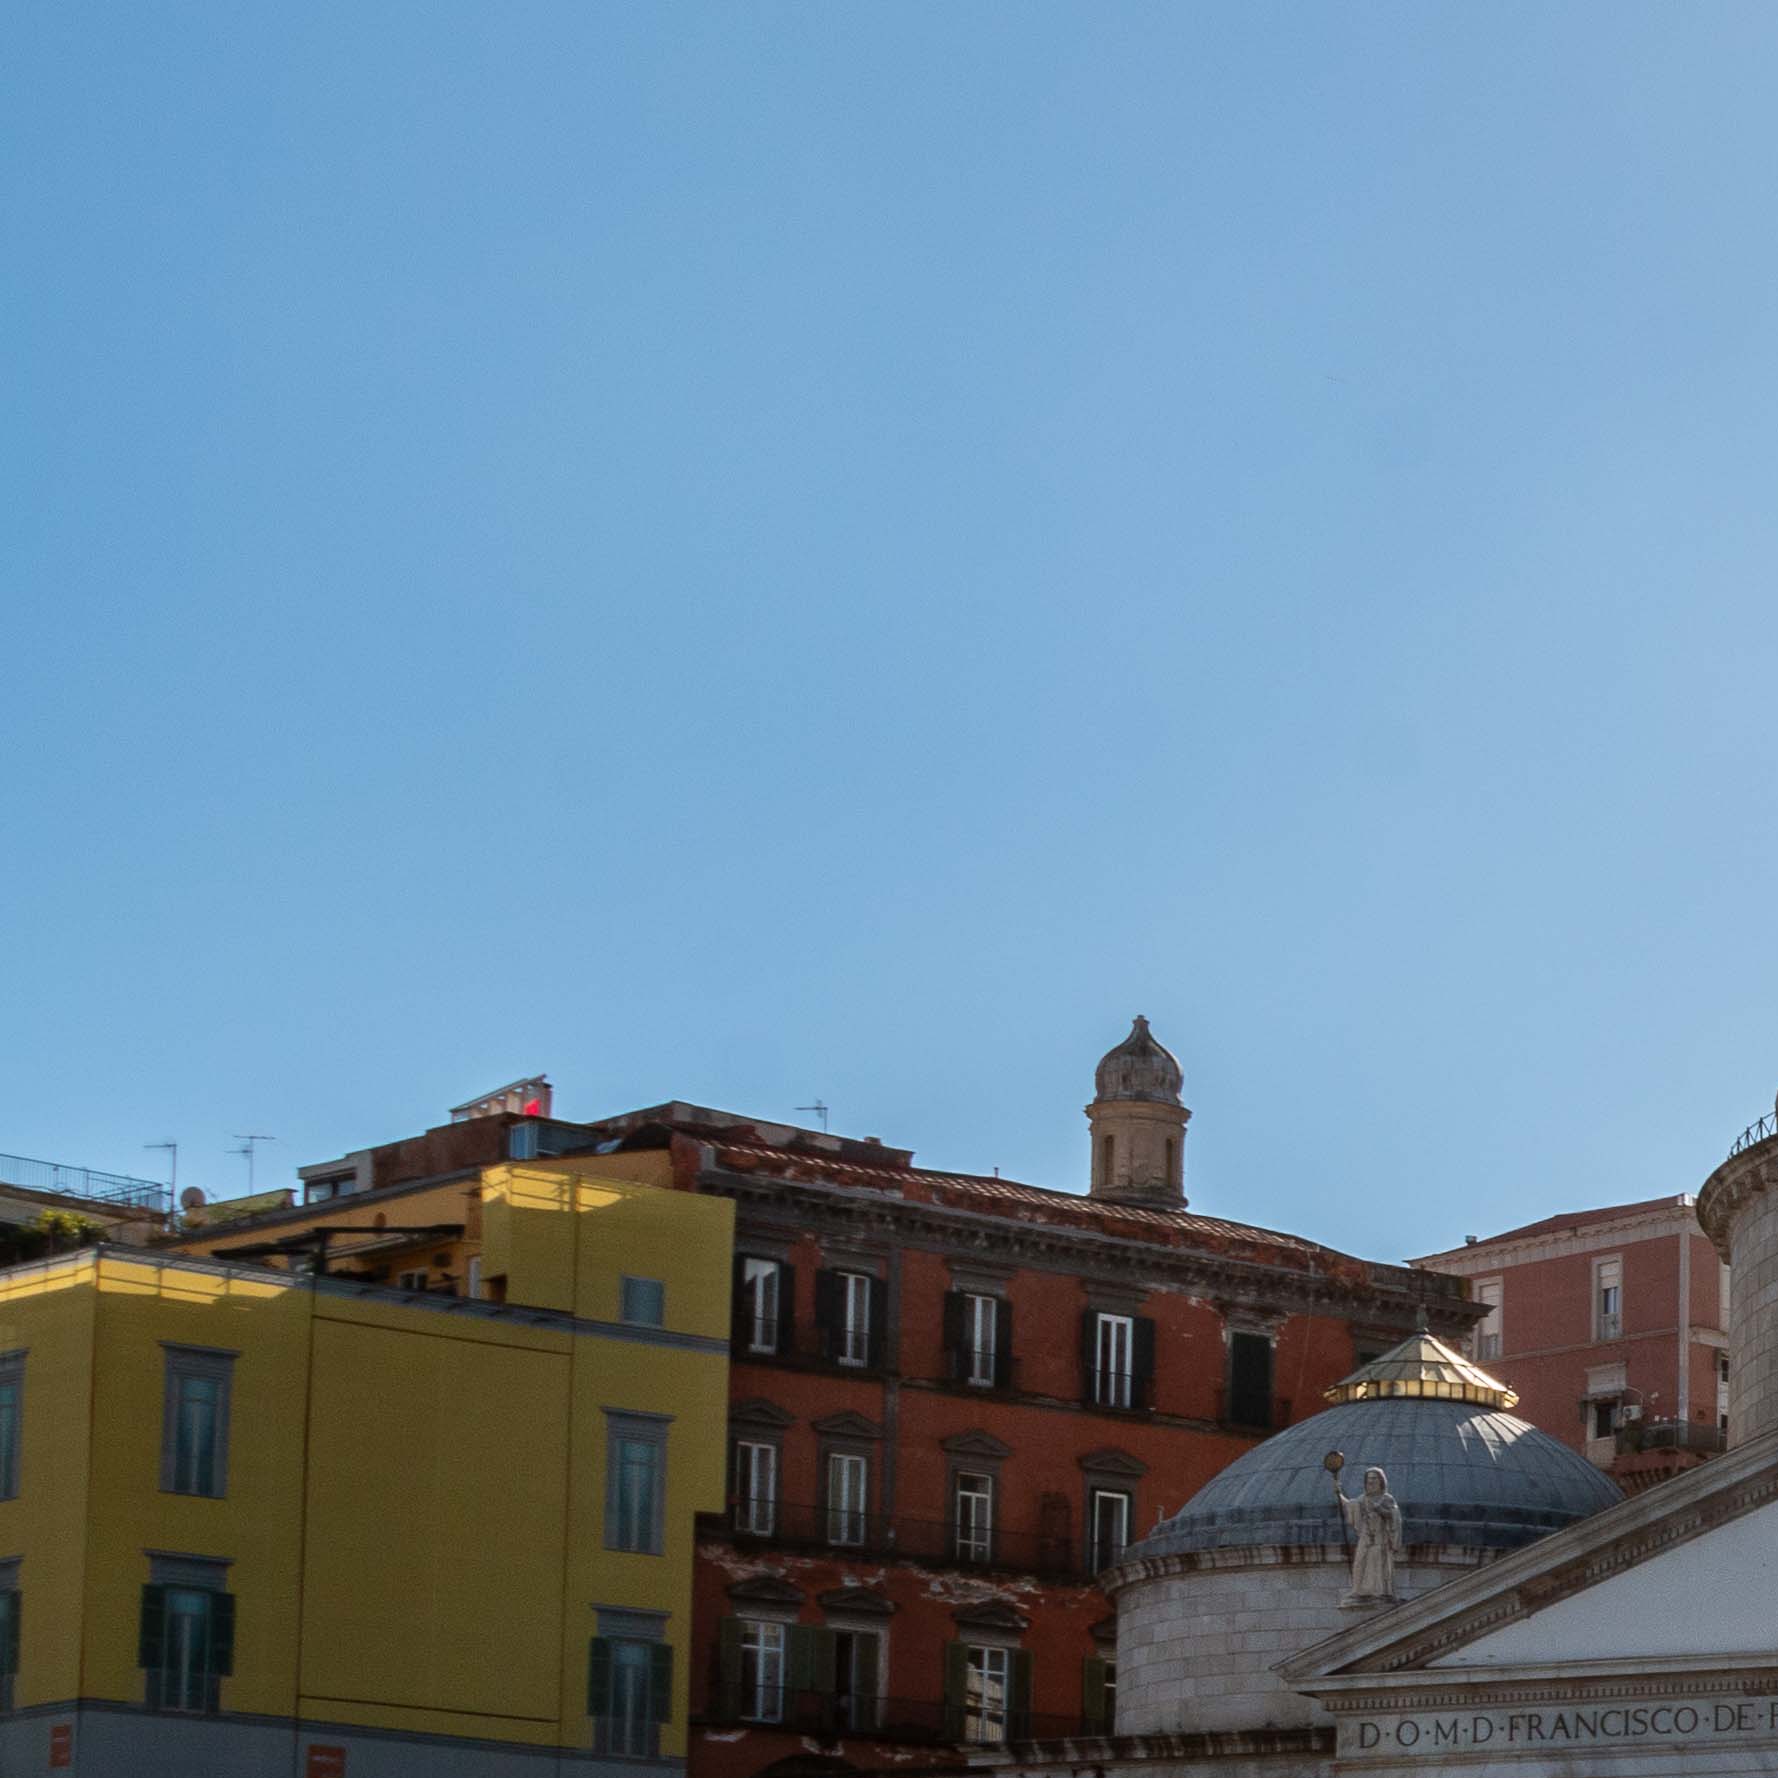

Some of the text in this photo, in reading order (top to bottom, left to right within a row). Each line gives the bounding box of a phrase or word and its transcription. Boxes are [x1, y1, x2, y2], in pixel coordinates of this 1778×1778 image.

[1358, 1722, 1381, 1749] D
[1395, 1719, 1420, 1747] O
[1433, 1718, 1459, 1746] M
[1471, 1716, 1494, 1744] D
[1508, 1706, 1699, 1742] FRANCISCO
[1713, 1703, 1755, 1732] DE
